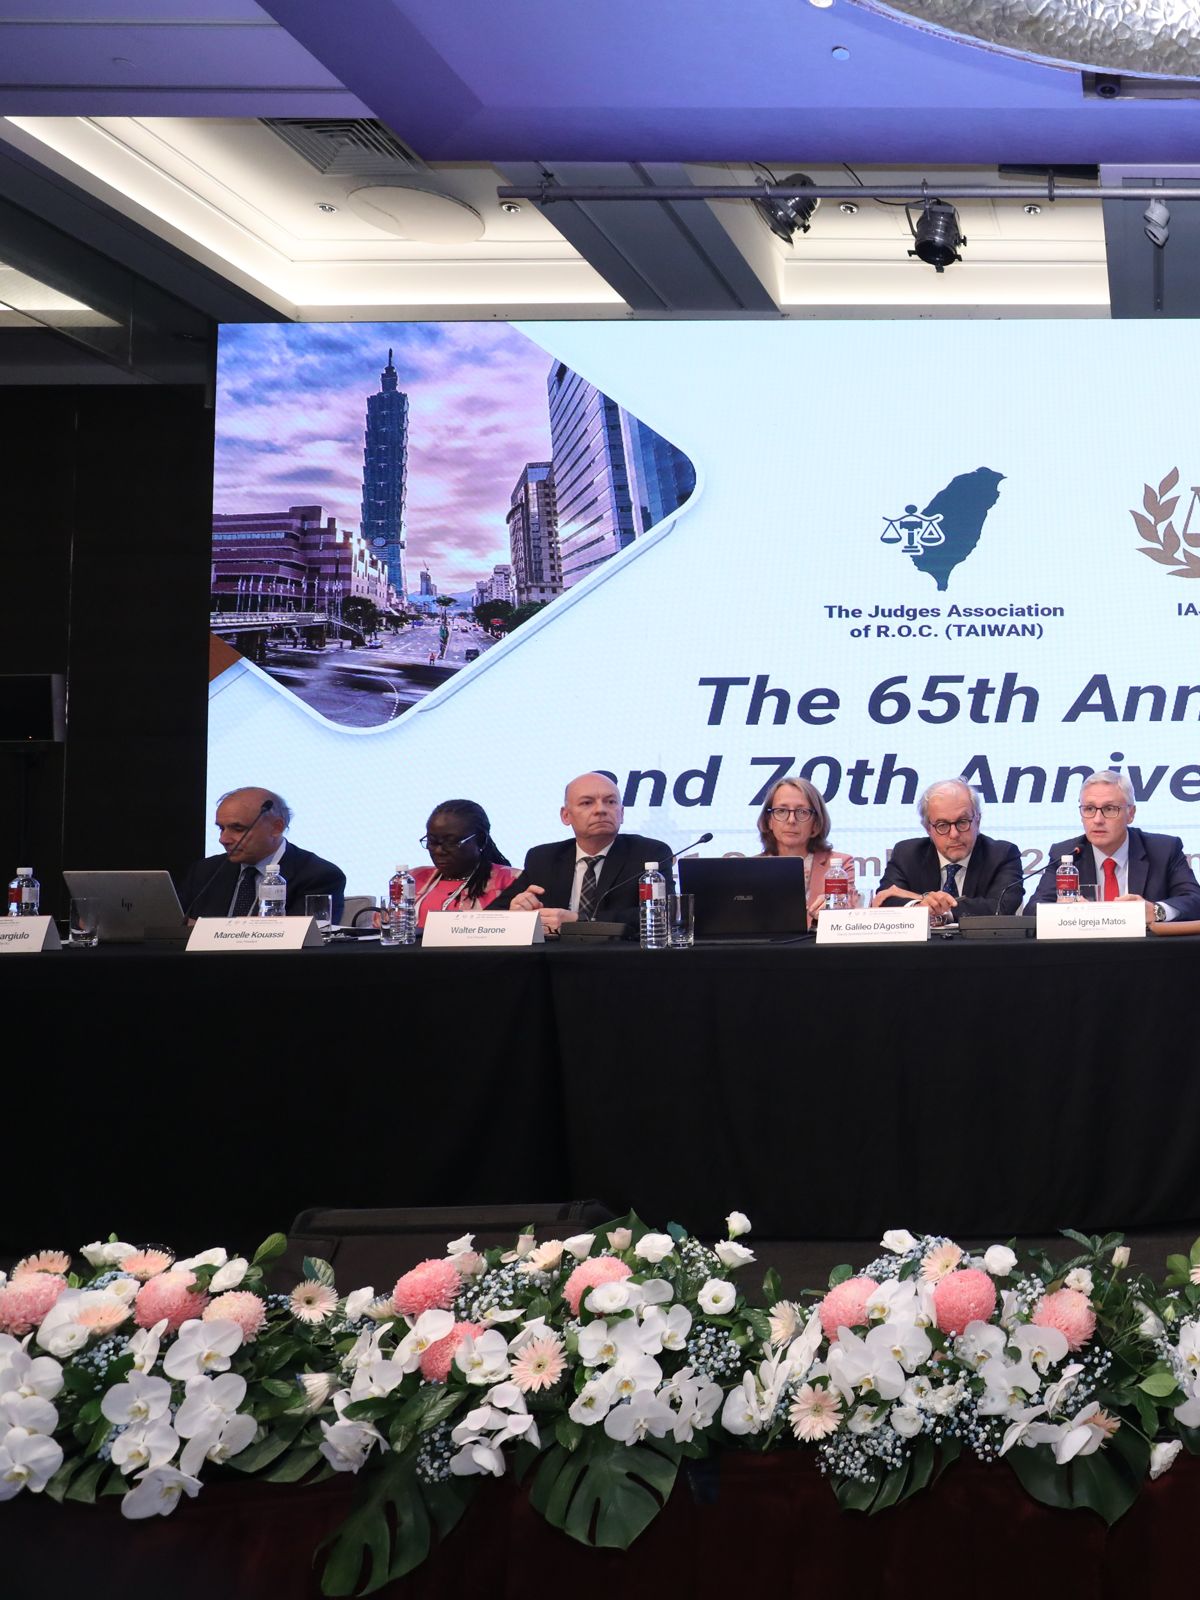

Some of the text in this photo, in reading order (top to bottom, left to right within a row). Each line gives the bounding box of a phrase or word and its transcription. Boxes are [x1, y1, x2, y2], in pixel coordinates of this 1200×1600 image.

[823, 603, 1065, 621] The Judges Association
[849, 622, 1044, 641] of R.O.C. (TAIWAN)
[698, 674, 840, 726] The
[867, 672, 1040, 725] 65th
[592, 755, 723, 807] nd
[748, 753, 919, 807] 70th
[844, 923, 872, 931] Galileo
[1058, 918, 1077, 926] José
[1078, 918, 1101, 928] Igreja
[213, 930, 284, 939] Marcelle Kouassi
[450, 926, 506, 935] Walter Barone
[0, 931, 30, 941] argiulo
